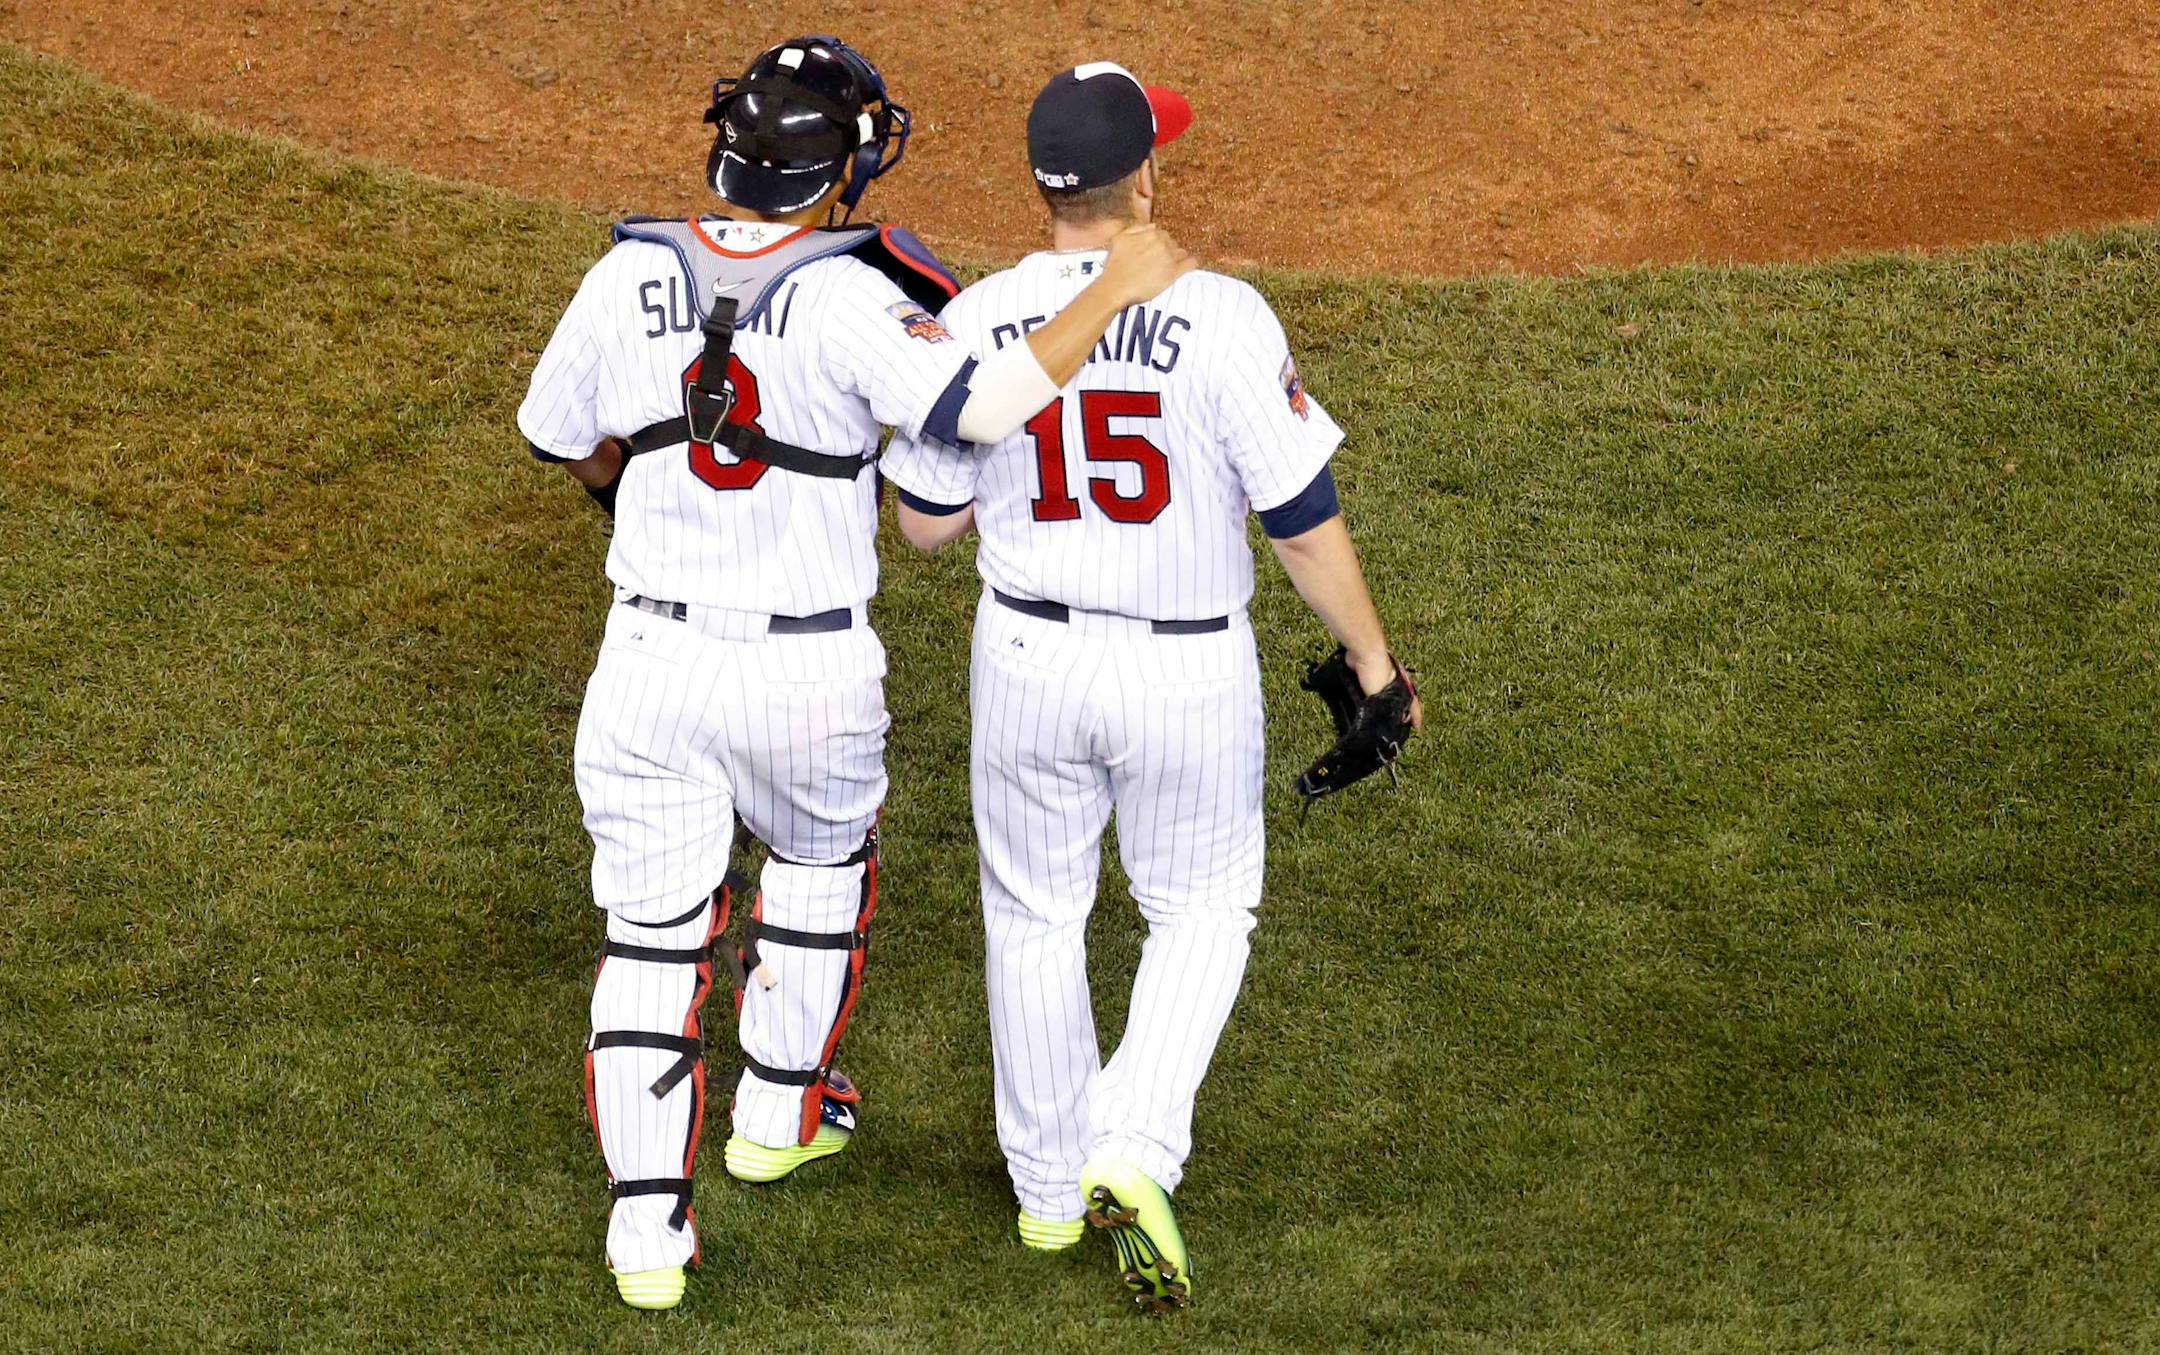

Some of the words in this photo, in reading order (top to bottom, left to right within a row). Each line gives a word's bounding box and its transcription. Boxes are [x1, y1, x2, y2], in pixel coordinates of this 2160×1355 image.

[639, 276, 799, 339] SUKI
[681, 352, 769, 490] 8
[1025, 389, 1172, 524] 15
